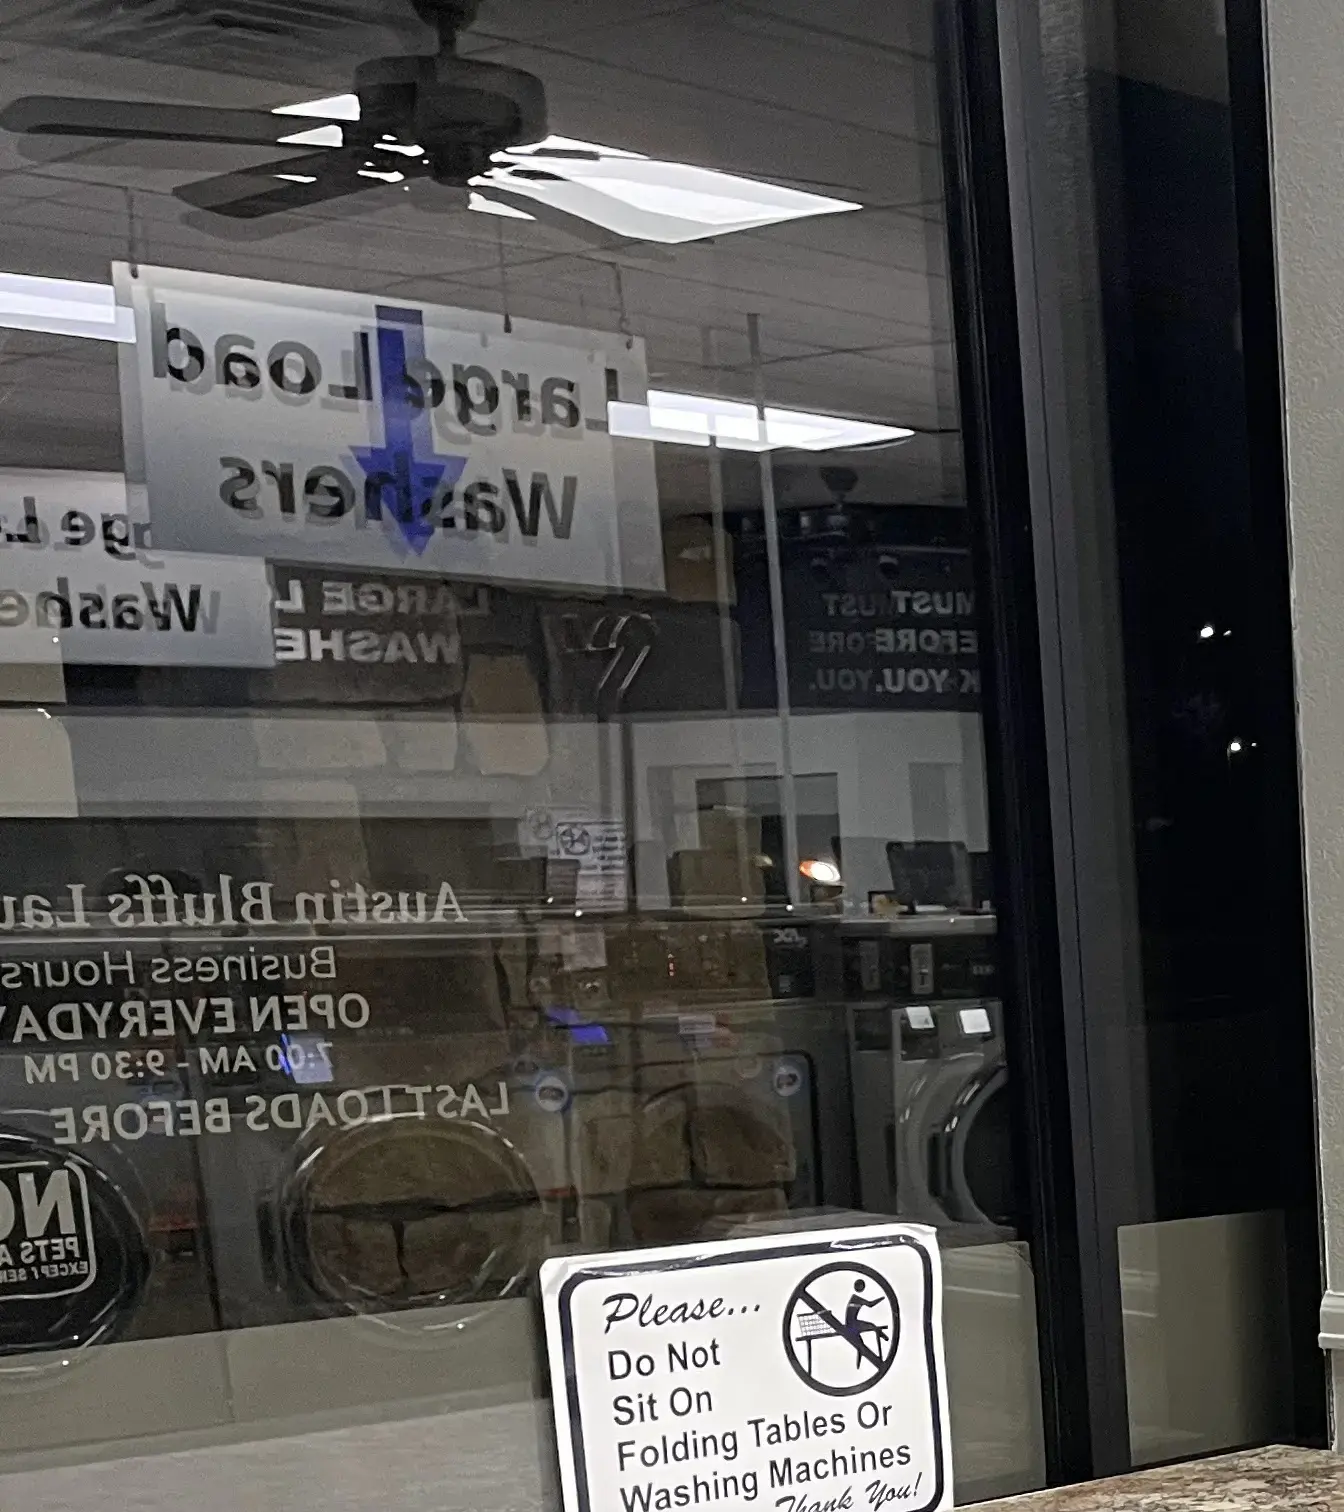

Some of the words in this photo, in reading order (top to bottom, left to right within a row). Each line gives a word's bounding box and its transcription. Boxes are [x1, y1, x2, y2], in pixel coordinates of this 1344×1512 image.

[603, 1292, 760, 1334] Please...
[608, 1350, 655, 1380] Do
[668, 1338, 721, 1373] Not
[612, 1393, 659, 1425] Sit
[669, 1387, 713, 1417] On
[617, 1430, 738, 1472] Folding
[747, 1410, 845, 1448] Tables
[857, 1401, 892, 1429] Or
[768, 1443, 911, 1489] Machines
[864, 1472, 923, 1512] You!
